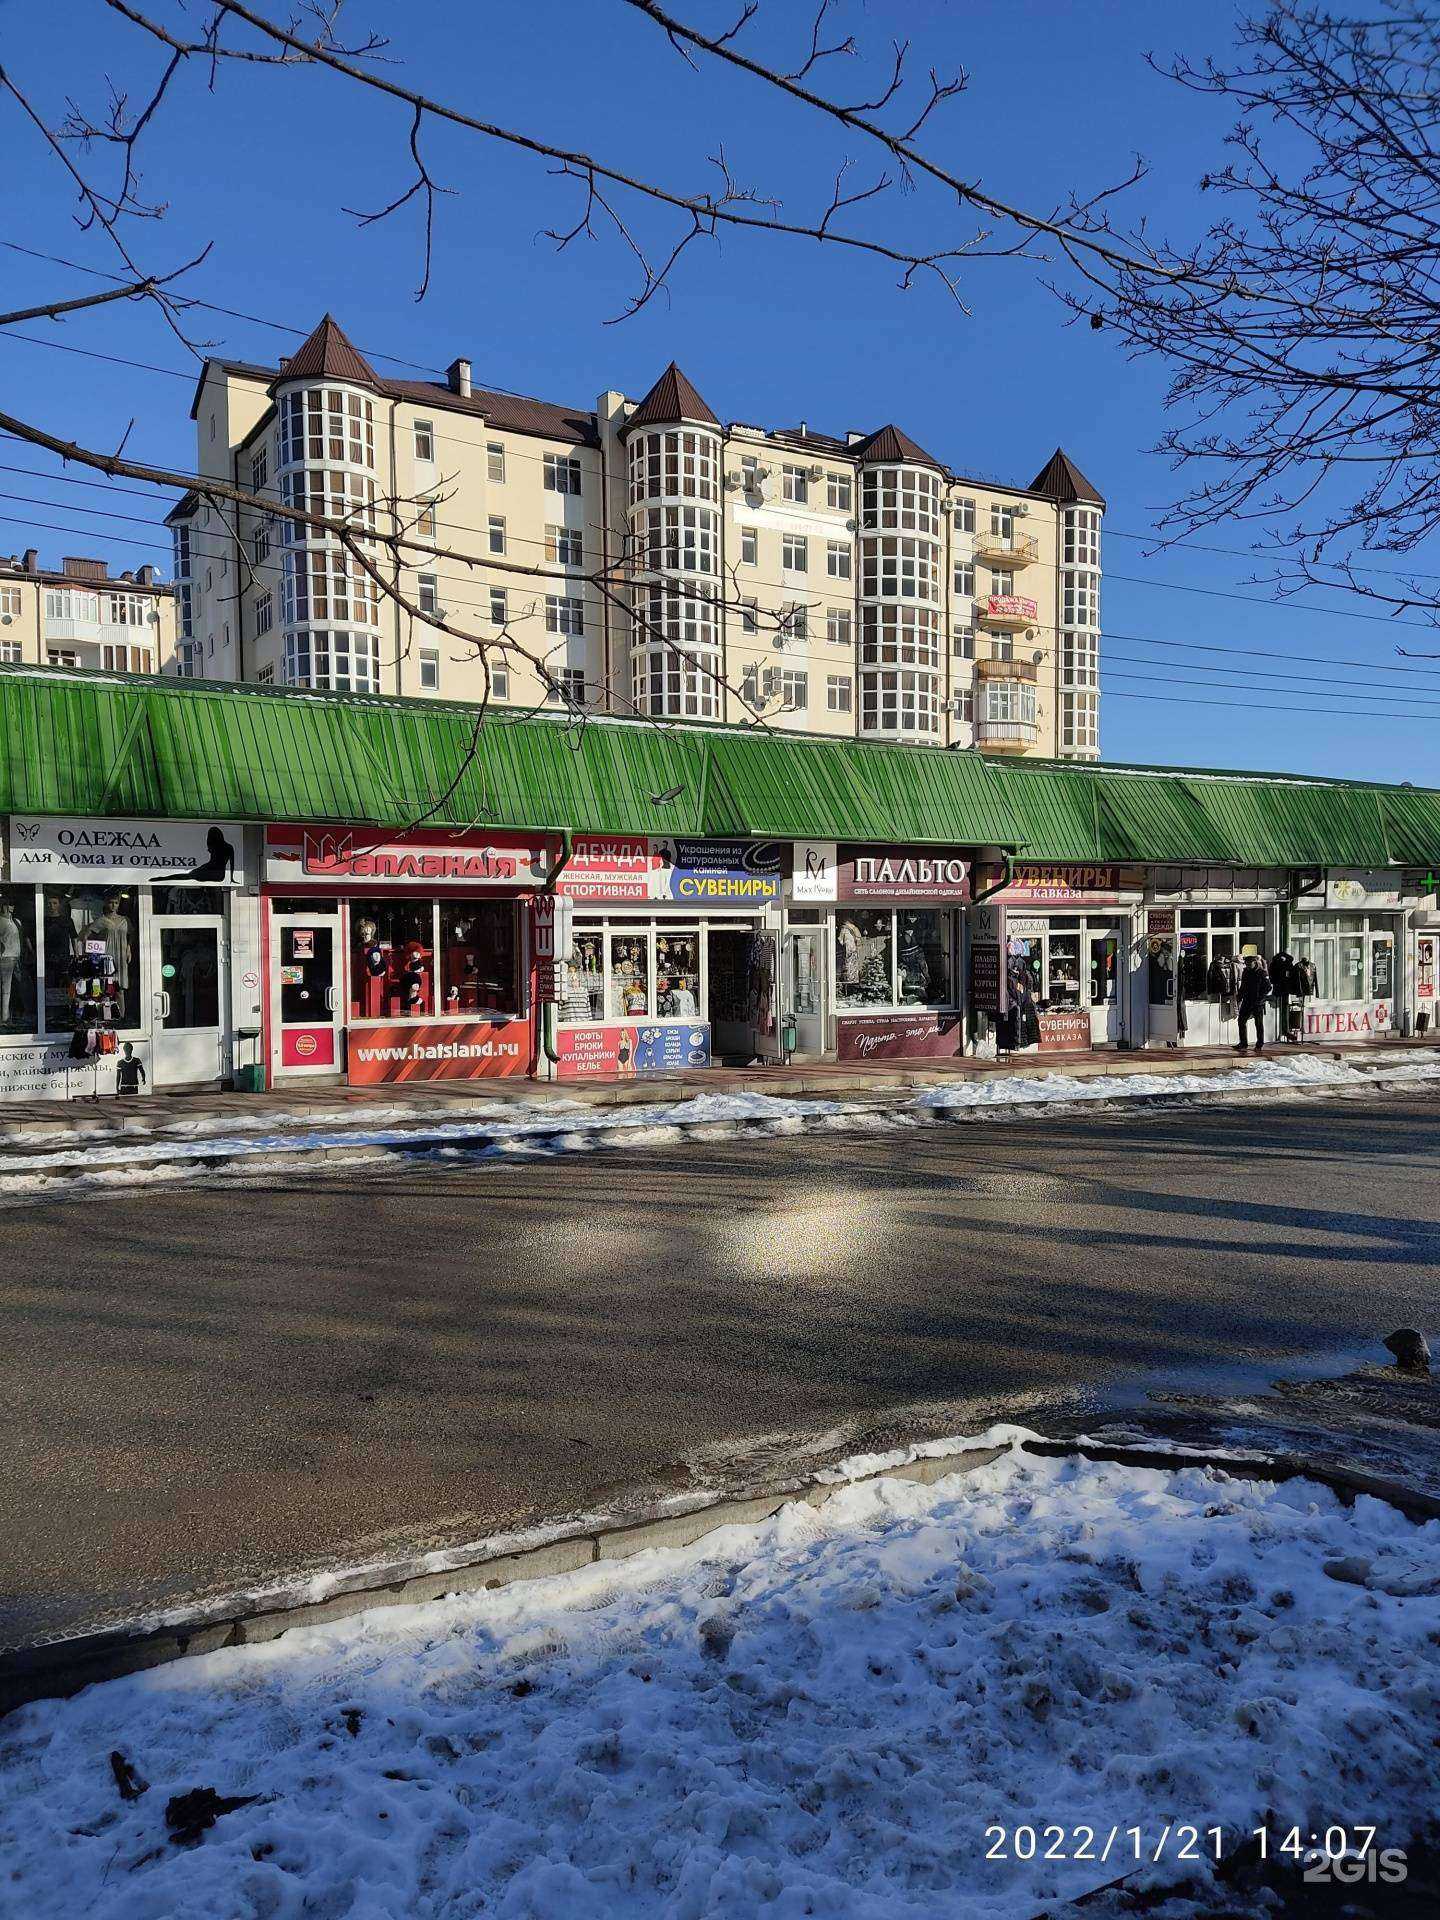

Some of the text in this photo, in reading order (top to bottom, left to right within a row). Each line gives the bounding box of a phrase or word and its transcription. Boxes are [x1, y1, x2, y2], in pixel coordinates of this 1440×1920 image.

[57, 829, 162, 849] ОДЕЖДА
[560, 842, 646, 867] ДЕЖДА
[679, 844, 743, 856] Украшения из
[19, 852, 198, 868] для дома и отдыха
[681, 856, 740, 866] натуральных
[693, 865, 729, 875] камней
[853, 857, 967, 884] ПАЛЬТО
[604, 873, 643, 882] МУЖСКАЯ
[1000, 865, 1113, 888] УВЕНИРЫ
[563, 884, 643, 897] СПОРТИВНАЯ
[679, 878, 777, 896] СУВЕНИРЫ
[1039, 1017, 1089, 1032] СУВЕНИРЫ
[1297, 1012, 1373, 1035] ПТЕКА
[574, 1031, 603, 1041] КОФТЫ
[1045, 1034, 1083, 1043] КАВКАЗА
[357, 1042, 519, 1063] www.hatsland.ru
[574, 1042, 603, 1051] БРЮКИ
[562, 1051, 616, 1062] КУПАЛЬНИКИ
[13, 1065, 54, 1076] майки,
[577, 1062, 601, 1071] БЕЛЬЕ
[0, 1082, 48, 1092] нижнее
